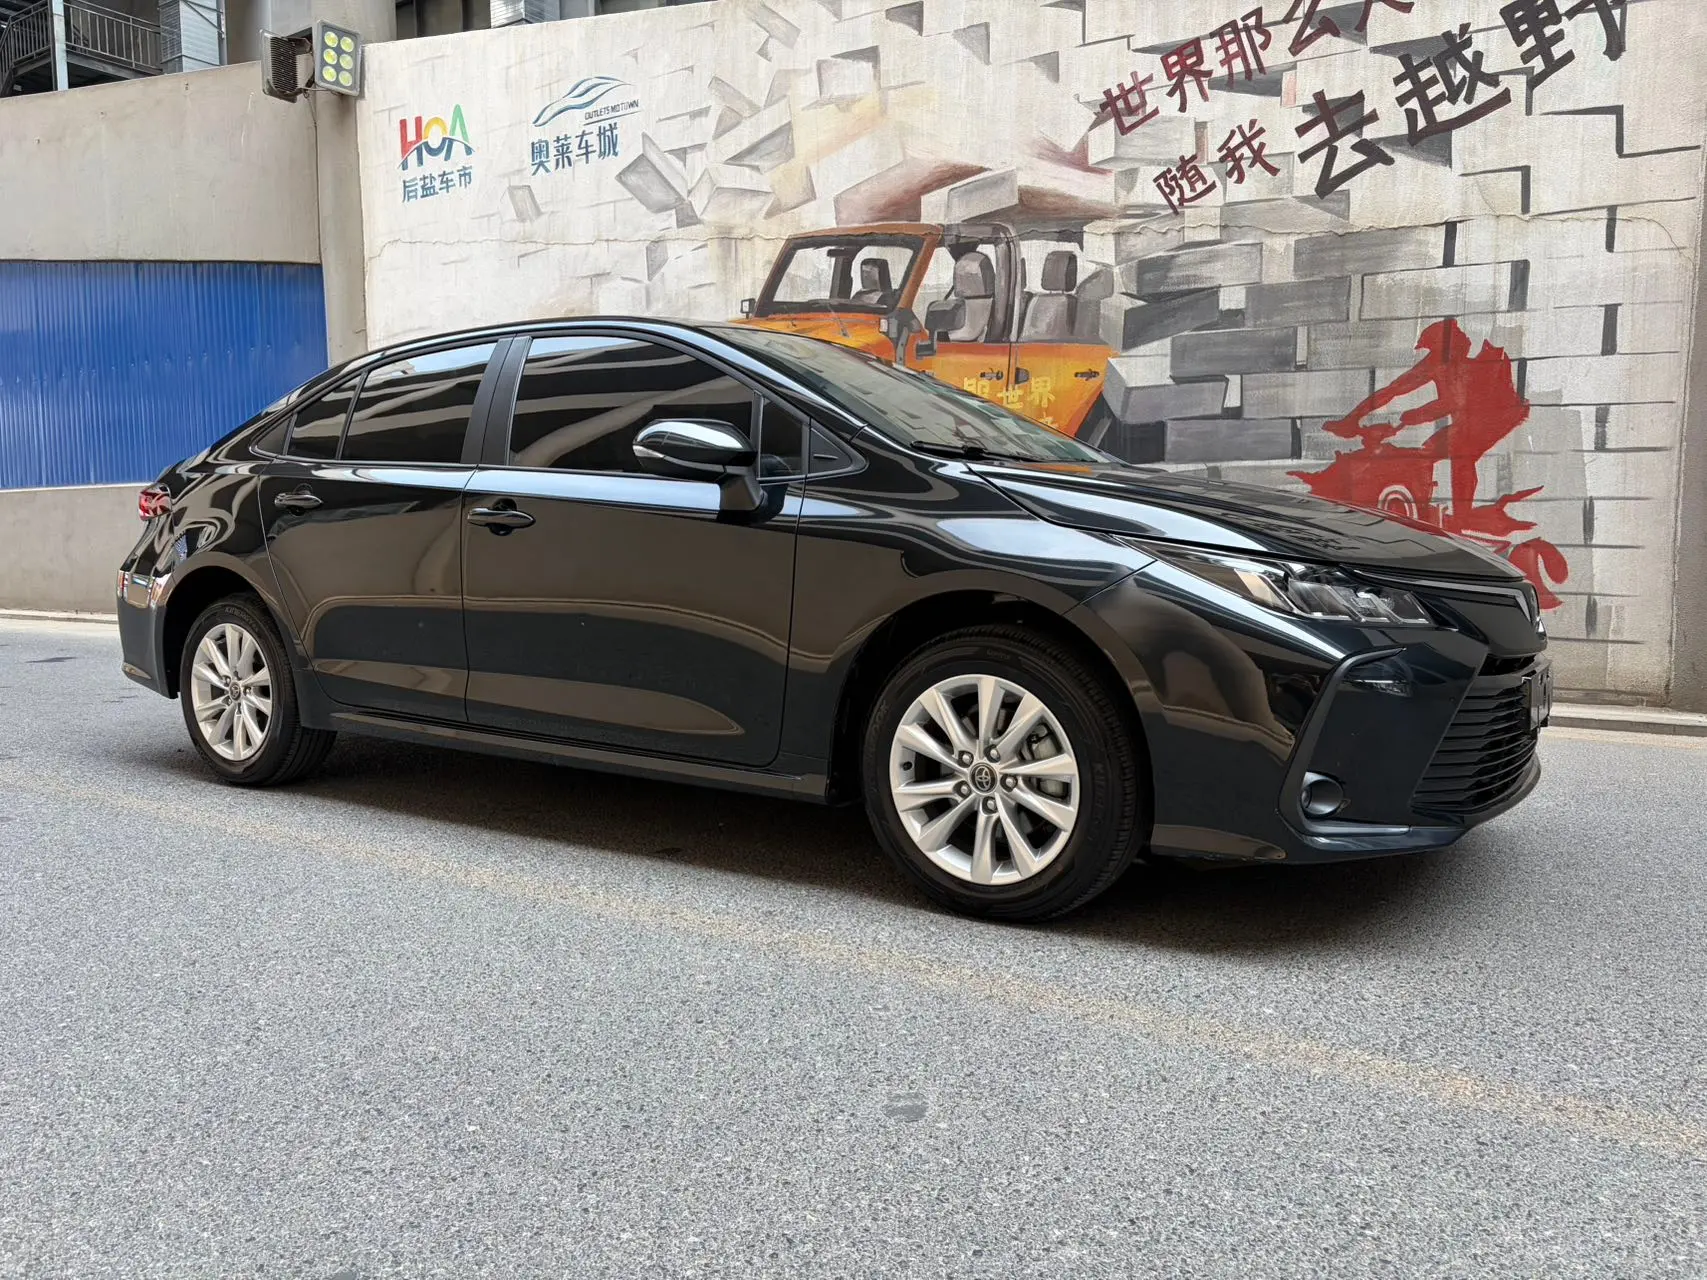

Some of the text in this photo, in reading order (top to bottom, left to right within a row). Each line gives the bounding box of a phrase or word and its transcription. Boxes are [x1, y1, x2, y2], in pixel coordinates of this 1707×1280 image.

[1100, 0, 1414, 136] 世界那么
[531, 122, 619, 176] 奥莱车城
[402, 165, 473, 203] 后盐车市
